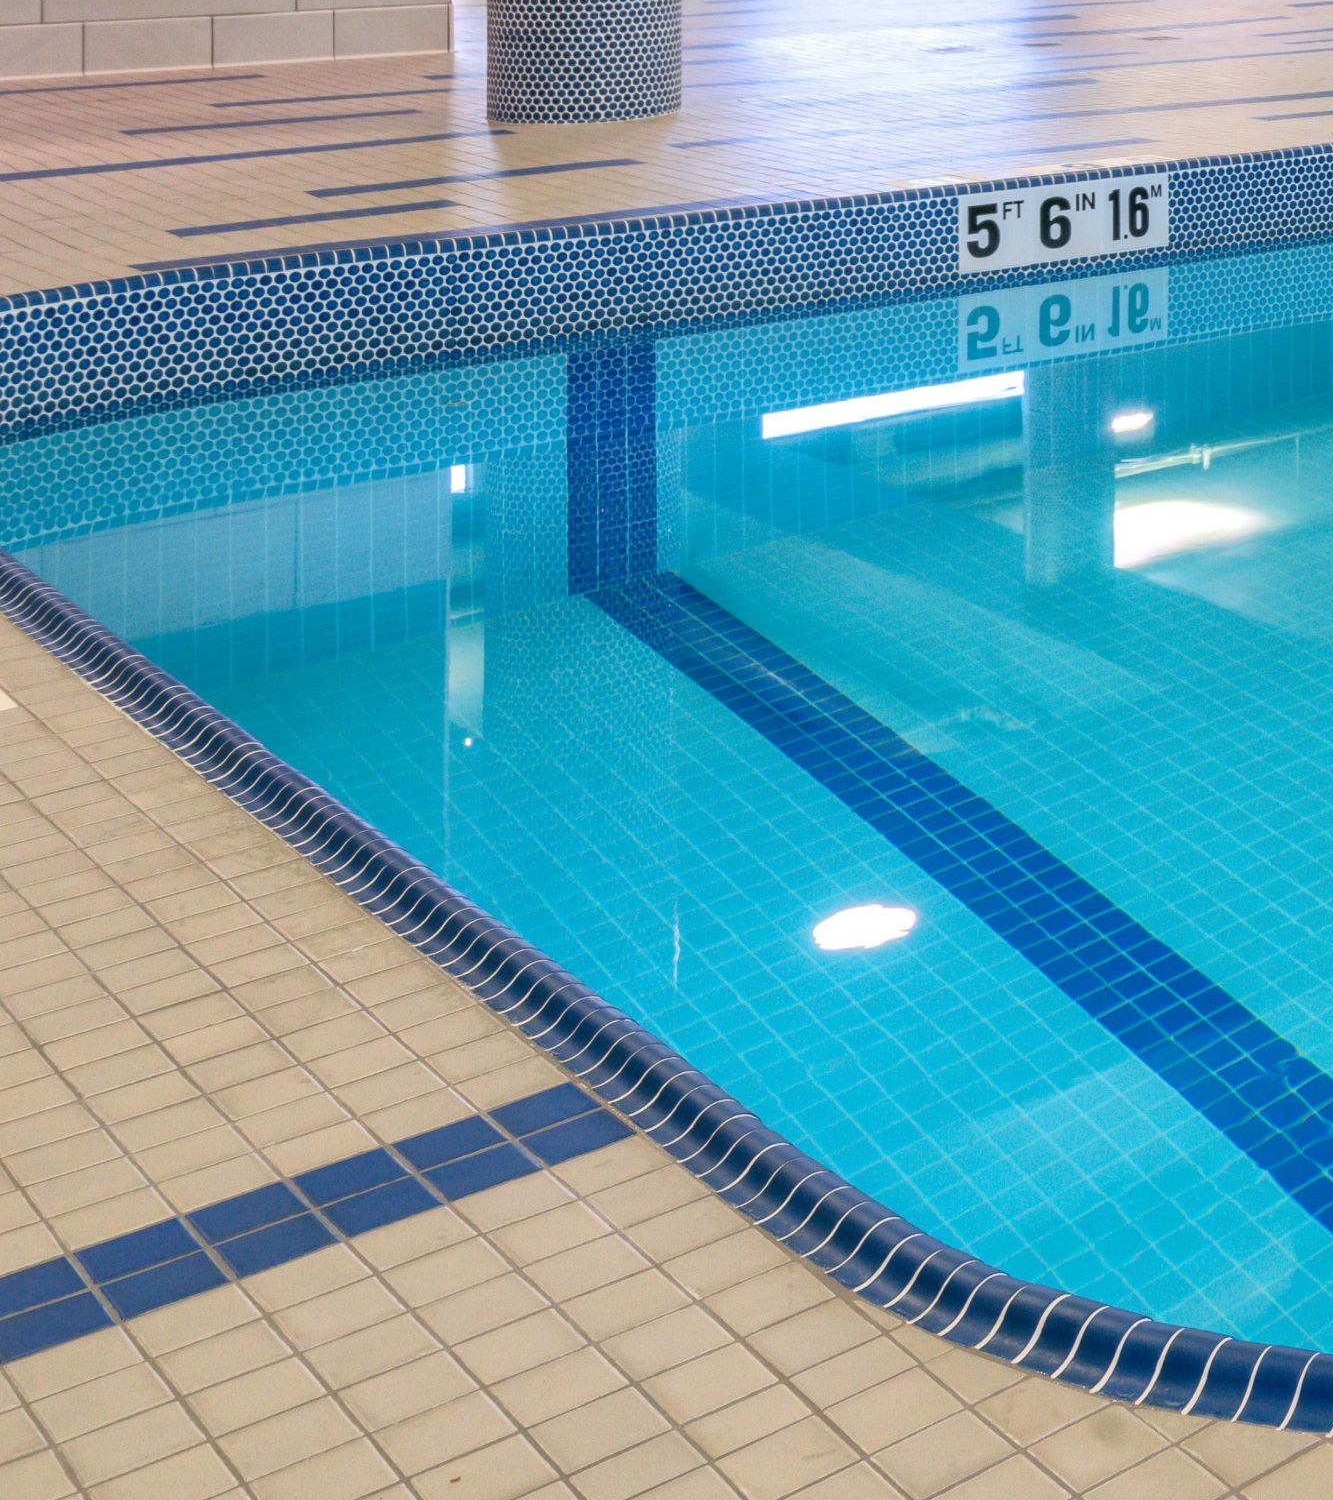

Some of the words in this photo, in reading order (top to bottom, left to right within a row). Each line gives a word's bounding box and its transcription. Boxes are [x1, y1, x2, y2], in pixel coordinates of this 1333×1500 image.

[966, 203, 1000, 258] 5
[1002, 200, 1024, 220] FT
[1039, 196, 1072, 249] 6
[1075, 192, 1096, 211] IN
[1108, 186, 1149, 241] 1.6
